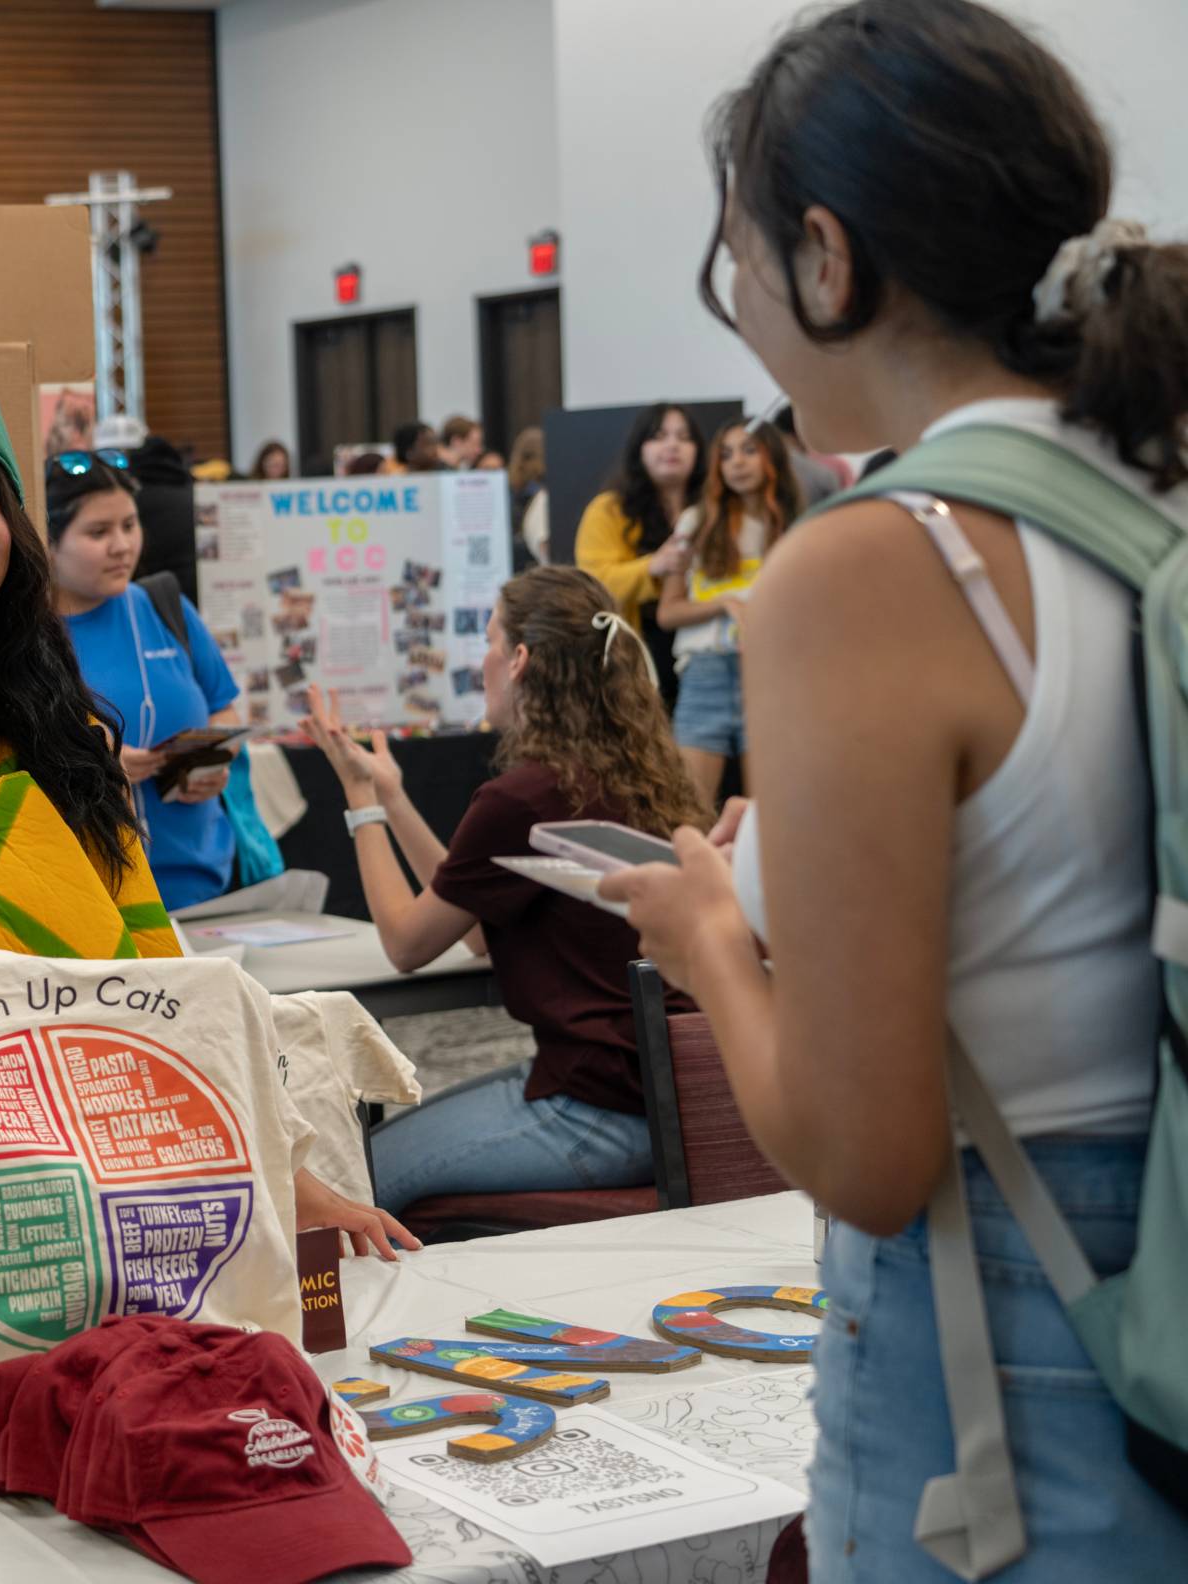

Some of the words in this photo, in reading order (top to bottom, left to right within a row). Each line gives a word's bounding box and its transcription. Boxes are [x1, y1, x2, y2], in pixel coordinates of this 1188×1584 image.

[269, 487, 419, 517] WELCOME
[326, 518, 369, 544] TO
[26, 977, 78, 1015] Up
[96, 976, 181, 1020] Cats
[64, 1046, 92, 1082] BREAD
[89, 1051, 137, 1078] PASTA
[75, 1075, 132, 1097] SPAGHETTI
[16, 1087, 59, 1144] STRAWBERRY
[80, 1089, 146, 1116] NOODLES
[109, 1108, 184, 1140] OATMEAL
[88, 1119, 114, 1156] BARLEY
[115, 1138, 151, 1155] GRAINS
[102, 1156, 134, 1171] BROWN
[135, 1154, 156, 1169] RICE
[155, 1137, 227, 1165] CRACKERS
[1, 1185, 33, 1200] RADISH
[33, 1178, 75, 1196] CARROTS
[3, 1197, 63, 1222] CUCUMBER
[119, 1207, 135, 1219] TOFU
[137, 1205, 181, 1226] TURKEY
[181, 1209, 203, 1223] EGGS
[21, 1223, 67, 1244] LETTUCE
[201, 1201, 228, 1247] NUTS
[120, 1221, 142, 1254] BEEF
[143, 1226, 204, 1255] PROTEIN
[33, 1241, 84, 1263] BROCCOLI
[124, 1257, 153, 1283] FISH
[152, 1251, 199, 1284] SEEDS
[8, 1290, 63, 1314] PUMPKIN
[61, 1261, 87, 1331] RHUBARB
[127, 1283, 154, 1302] PORK
[154, 1282, 187, 1309] VEAL
